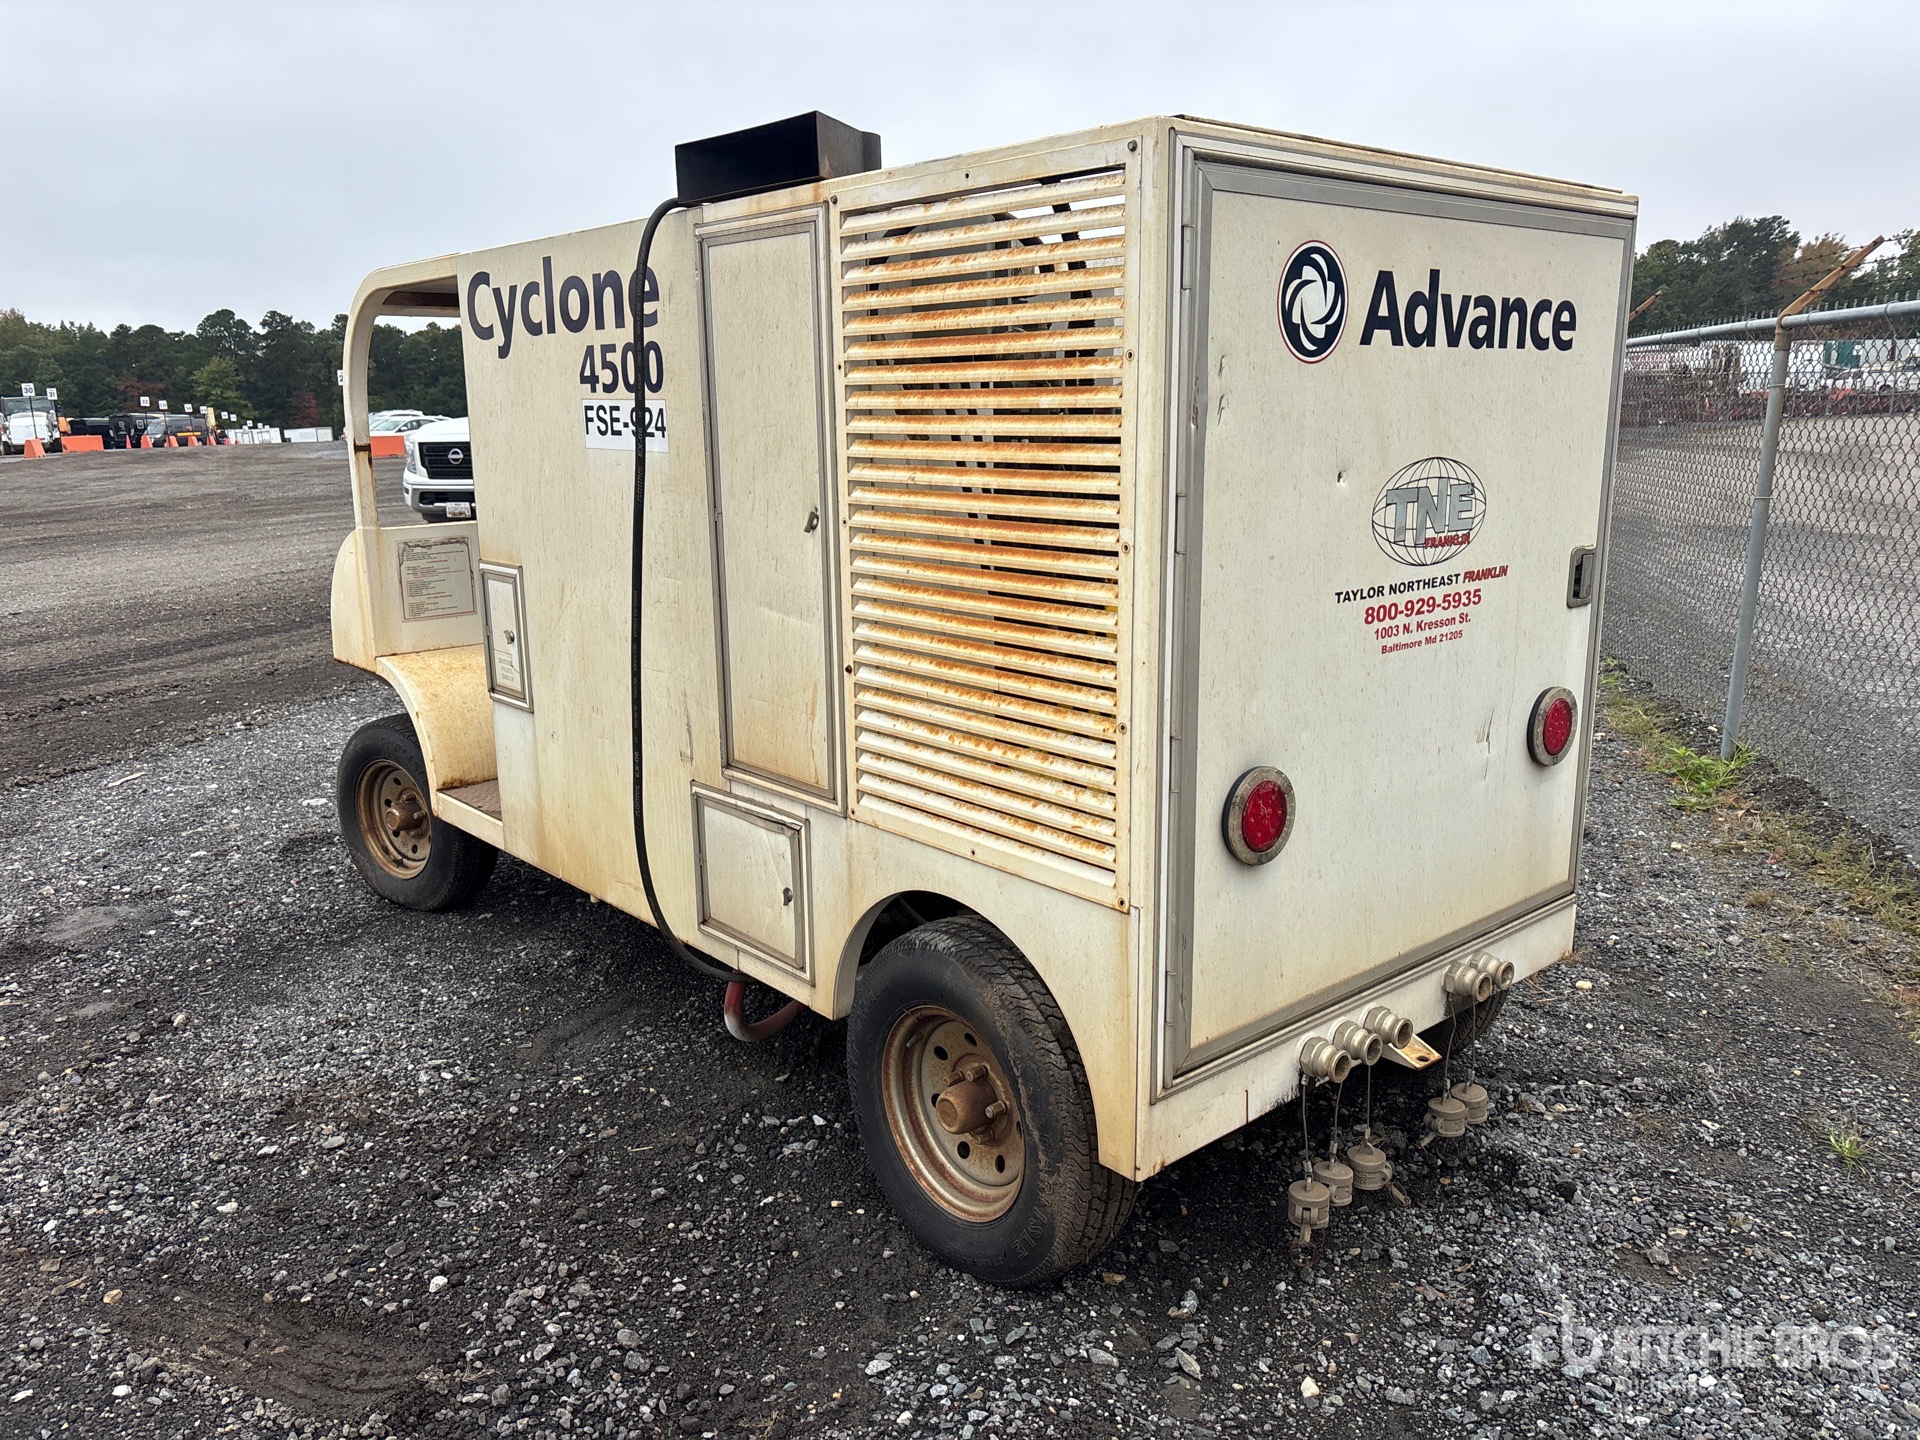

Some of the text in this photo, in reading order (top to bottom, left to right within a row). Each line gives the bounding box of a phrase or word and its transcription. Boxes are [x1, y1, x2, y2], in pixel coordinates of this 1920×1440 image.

[467, 256, 660, 359] Cyclone
[1359, 268, 1577, 352] Advance
[579, 340, 664, 394] 4500
[1385, 477, 1475, 545] TNE
[1424, 532, 1470, 549] FRANKLIN
[1335, 565, 1508, 604] TAYLOR NORTHEAST FRANKLIN
[1364, 588, 1482, 625] 800-929-5935
[1374, 612, 1471, 640] 1003 N. Kresson St.
[1381, 630, 1463, 654] Baltimore Md 21205
